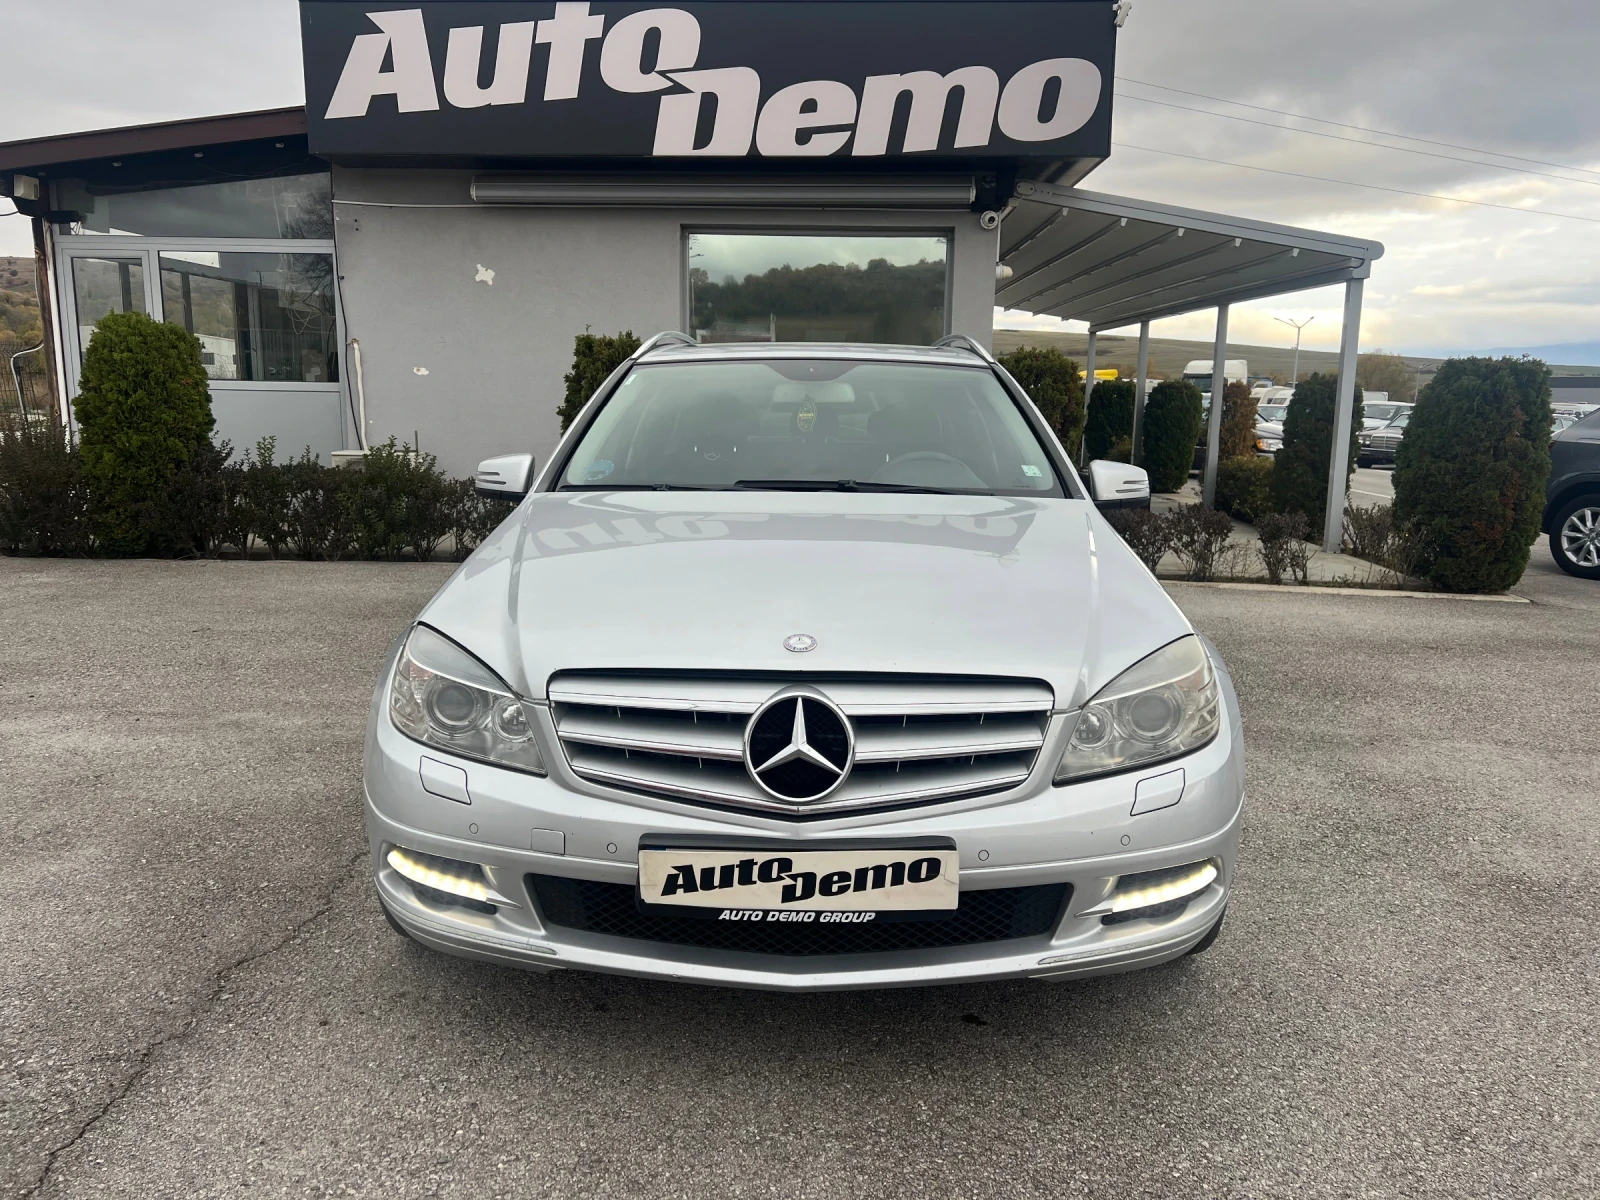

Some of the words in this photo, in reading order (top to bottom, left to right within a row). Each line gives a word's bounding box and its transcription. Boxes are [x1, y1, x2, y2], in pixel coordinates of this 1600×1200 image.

[325, 2, 701, 120] Auto
[653, 57, 1102, 156] Demo
[660, 857, 793, 896] Auto
[781, 857, 942, 904] Demo
[718, 909, 764, 922] AUTO
[766, 910, 816, 923] DEMO
[819, 911, 877, 923] GROUP
